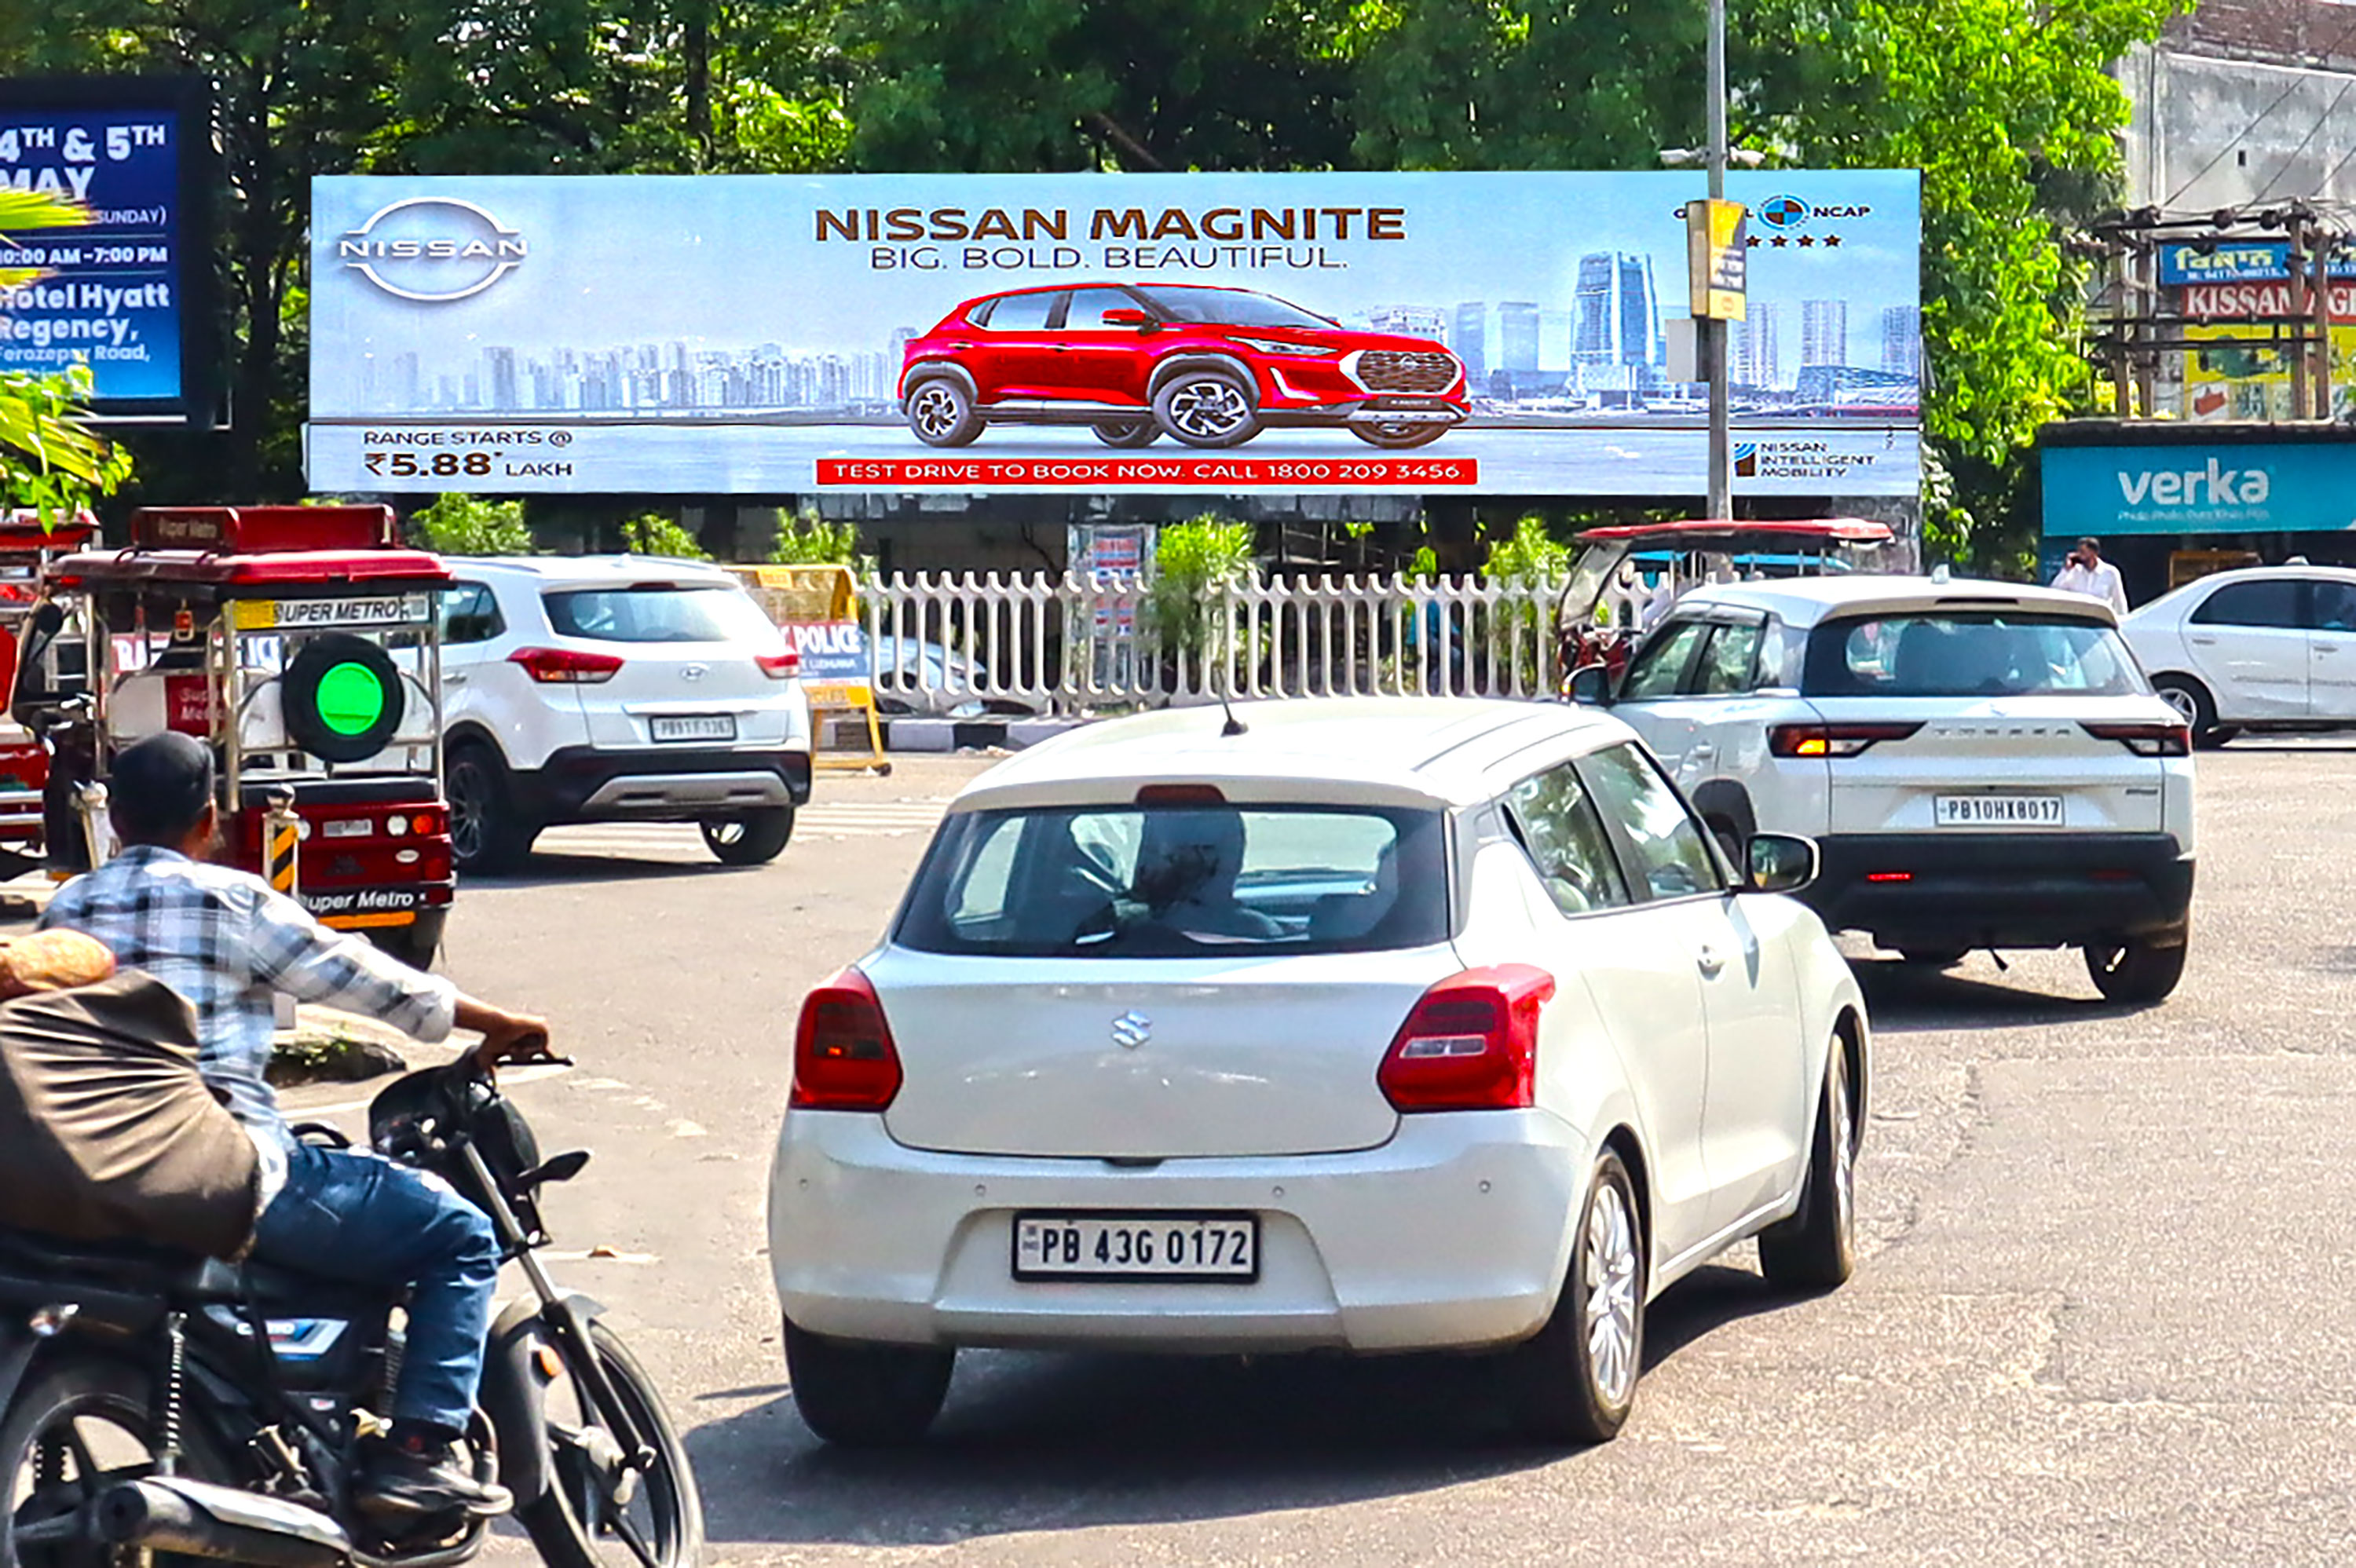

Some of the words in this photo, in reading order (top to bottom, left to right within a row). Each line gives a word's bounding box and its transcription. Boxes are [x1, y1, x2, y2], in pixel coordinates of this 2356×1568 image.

[0, 128, 55, 163] 4TH
[62, 127, 96, 162] &
[106, 124, 166, 161] 5TH
[1813, 206, 1871, 218] NCAP
[815, 208, 1067, 241] NISSAN
[1090, 207, 1405, 241] MAGNITE
[49, 248, 81, 264] AM
[137, 247, 168, 262] PM
[339, 238, 529, 258] NISSAN
[871, 247, 948, 269] BIG.
[962, 247, 1090, 269] BOLD.
[1104, 246, 1348, 269] BEAUTIFUL.
[80, 283, 170, 316] Hyatt
[0, 317, 139, 347] Regency,
[0, 347, 91, 366] erozepr
[94, 343, 151, 363] Road,
[364, 430, 444, 445] RANGE
[450, 430, 543, 445] STARTS
[547, 430, 573, 448] @
[1760, 443, 1828, 452] NISSAN
[505, 462, 573, 477] LAKH
[1760, 455, 1876, 466] INTELLIGENT
[832, 463, 898, 478] TEST
[905, 463, 981, 479] DRIVE
[987, 463, 1026, 478] TO
[1032, 463, 1110, 479] BOOK
[1117, 463, 1186, 478] NOW.
[1193, 463, 1258, 479] CALL
[1267, 463, 1330, 478] 1800
[1338, 463, 1388, 479] 209
[1760, 467, 1848, 477] MOBILITY
[2118, 458, 2269, 505] verka
[273, 601, 334, 624] SUPER
[335, 600, 397, 623] METRO
[792, 625, 862, 654] POLICE
[1948, 800, 2060, 820] PB10HX8017
[357, 890, 415, 908] Metro
[1041, 1228, 1081, 1263] PB
[1093, 1229, 1154, 1264] 43G
[1165, 1230, 1248, 1265] 0172
